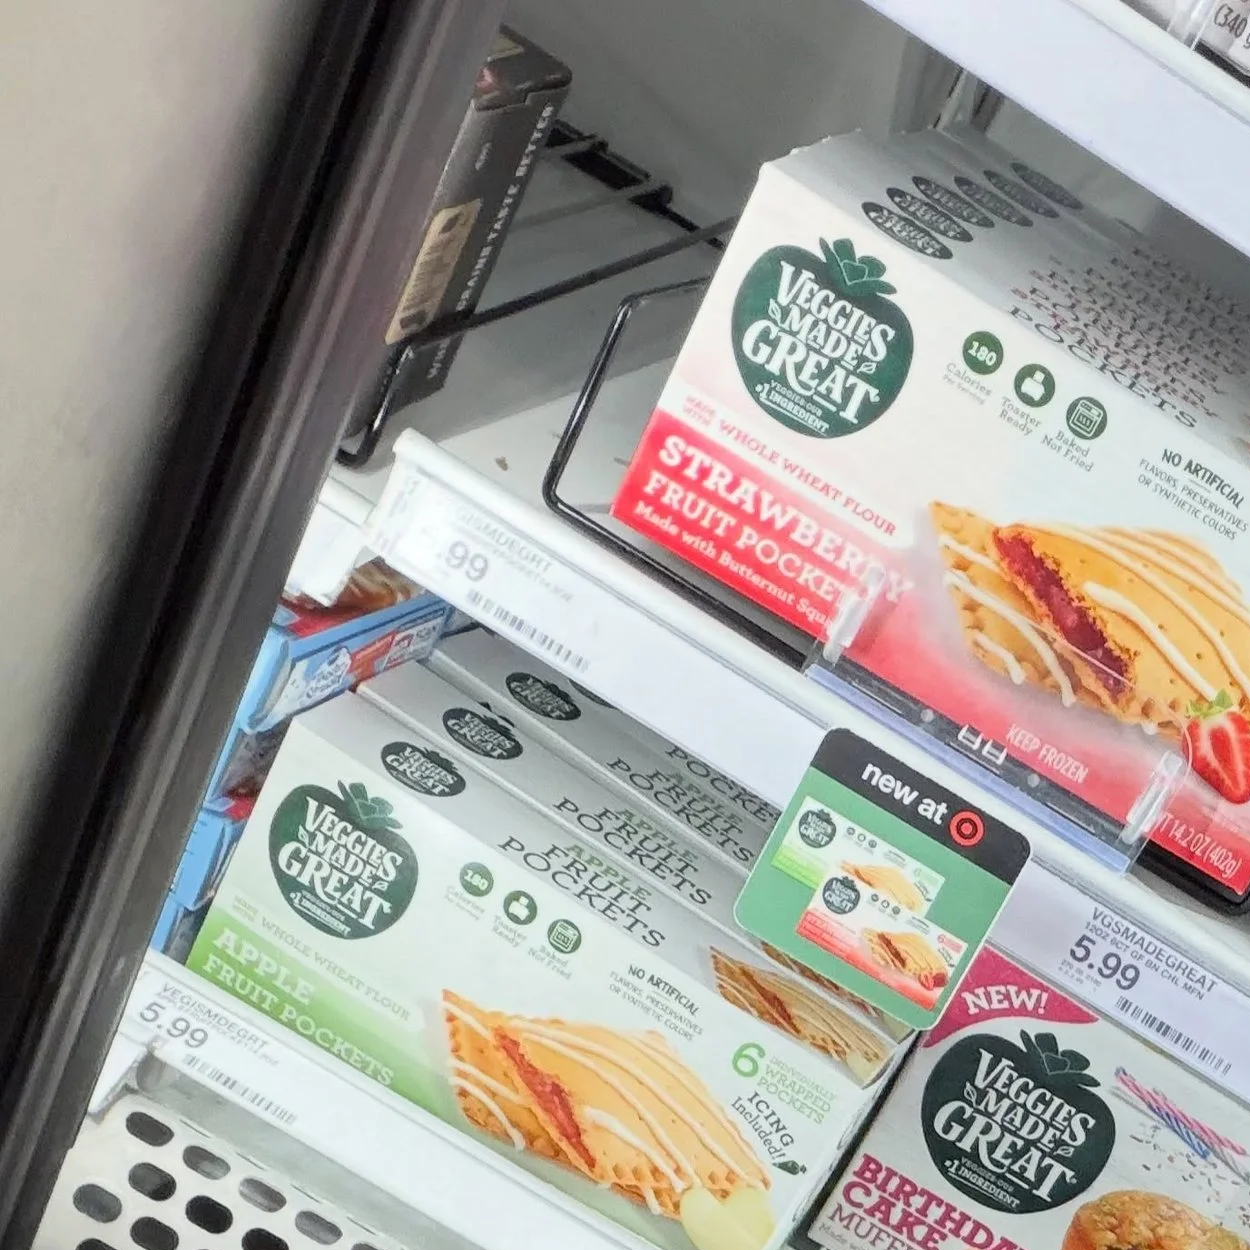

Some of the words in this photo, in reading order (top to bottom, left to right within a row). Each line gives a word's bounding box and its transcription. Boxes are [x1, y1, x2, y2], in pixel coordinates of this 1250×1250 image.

[1213, 3, 1249, 38] (340
[773, 258, 897, 364] VEGGIES
[779, 303, 863, 371] MADE
[740, 317, 879, 426] GREAT
[967, 340, 997, 366] 180
[768, 390, 829, 434] INGREDIENT
[719, 419, 780, 464] WHOLE
[783, 458, 843, 502] WHEAT
[842, 496, 897, 537] FLOUR
[1137, 473, 1153, 489] OR
[1152, 482, 1202, 519] SYNTHETIC
[1201, 514, 1237, 541] COLORS
[1139, 458, 1180, 491] FLAVORS,
[1180, 484, 1249, 533] PRESERVATIVES
[1160, 447, 1183, 468] NO
[1182, 458, 1246, 510] ARTIFICIAL
[634, 500, 679, 536] Made
[681, 530, 717, 559] with
[718, 550, 796, 606] Butternut
[1005, 723, 1041, 753] KEEP
[1037, 743, 1089, 784] FROZEN
[861, 762, 919, 806] new
[917, 796, 948, 825] at
[301, 795, 405, 883] VEGGIES
[307, 831, 378, 887] MADE
[546, 795, 715, 906] POCKETS
[561, 843, 653, 902] APPLE
[1168, 819, 1195, 847] 14.2
[1187, 832, 1211, 856] OZ
[1201, 840, 1243, 880] (402g)
[276, 839, 392, 931] GREAT
[495, 834, 668, 949] POCKETS
[531, 842, 653, 916] FRUIT
[209, 926, 321, 1006] APPLE
[1068, 933, 1142, 992] 5.99
[1084, 921, 1110, 941] 12OZ
[1109, 936, 1130, 953] 6CT
[1129, 949, 1145, 962] GF
[1144, 958, 1160, 973] BN
[1160, 968, 1180, 987] CHL
[1181, 981, 1205, 1001] MFN
[1086, 906, 1222, 993] VGSMADEGREAT
[161, 982, 269, 1050] VEGISMDEGRT
[201, 952, 281, 1013] FRUIT
[277, 1003, 395, 1085] POCKETS
[627, 964, 645, 980] NO
[646, 973, 700, 1016] ARTIFICIAL
[962, 991, 1050, 1015] NEW!
[139, 1000, 209, 1050] 5.99
[730, 1040, 767, 1079] 6
[730, 1096, 786, 1160] Included!
[746, 1090, 794, 1147] ICING
[969, 1046, 1098, 1148] VEGGIES
[976, 1088, 1062, 1153] MADE
[931, 1097, 1075, 1203] GREAT
[957, 1166, 1021, 1209] INGREDIENT
